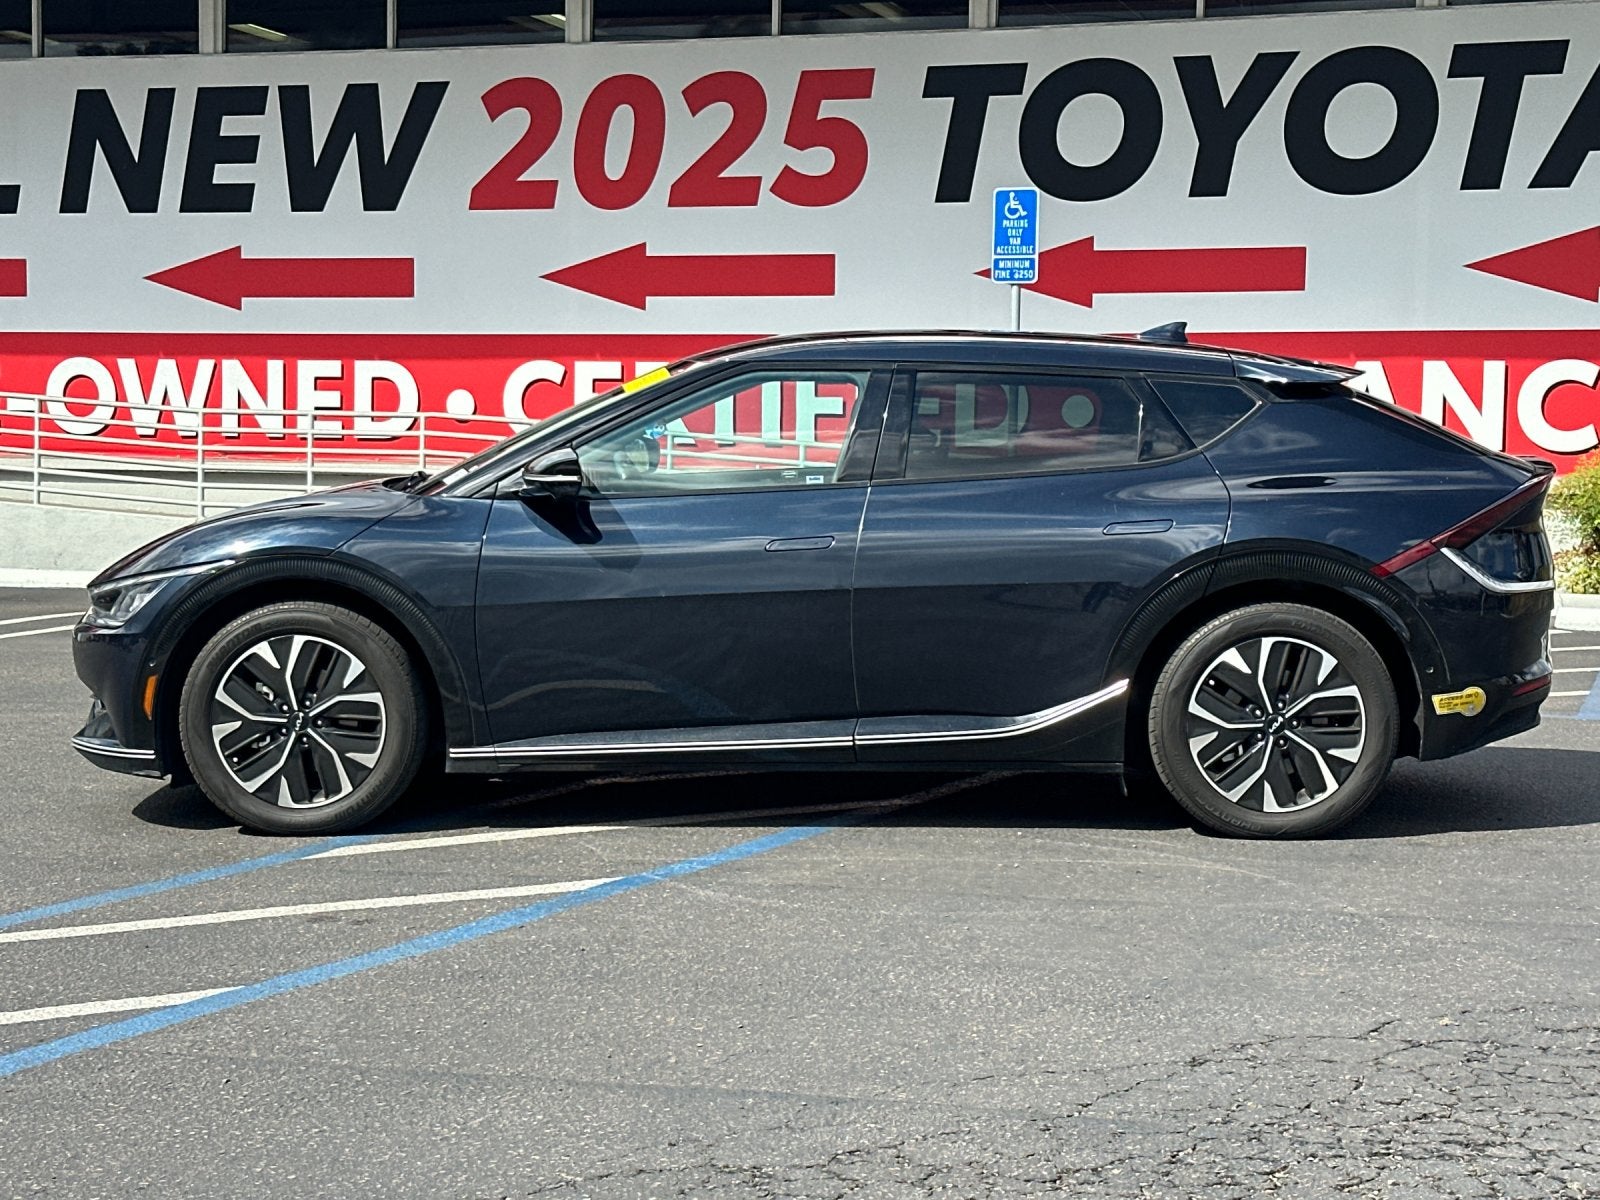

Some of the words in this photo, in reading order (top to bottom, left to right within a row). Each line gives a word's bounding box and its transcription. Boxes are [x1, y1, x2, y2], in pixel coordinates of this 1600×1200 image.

[60, 81, 450, 213] NEW
[469, 68, 875, 211] 2025
[922, 41, 1600, 203] TOYOTA
[1002, 219, 1029, 228] PARKING
[1007, 228, 1023, 237] ONLY
[1009, 237, 1021, 245] VAN
[996, 245, 1034, 254] ACCESSIBLE
[998, 260, 1030, 269] MINIMUM
[994, 269, 1011, 279] FINE
